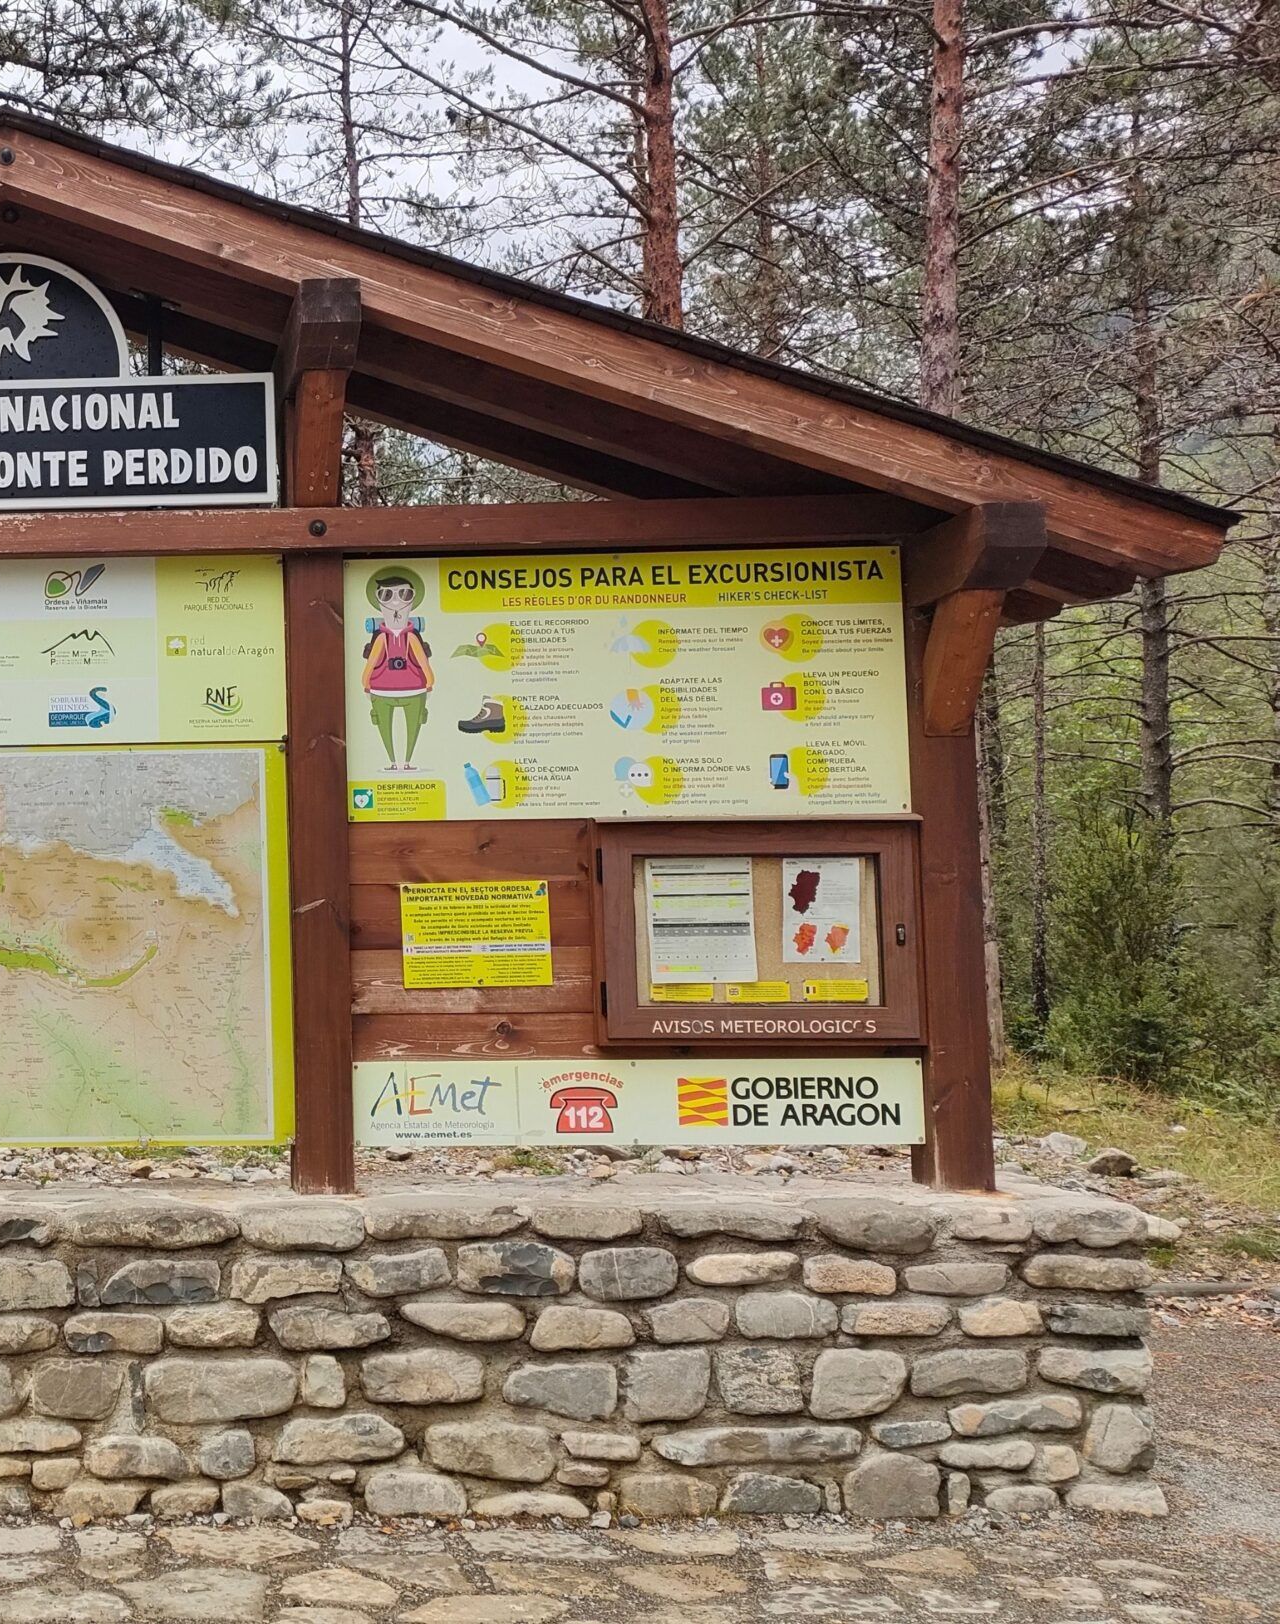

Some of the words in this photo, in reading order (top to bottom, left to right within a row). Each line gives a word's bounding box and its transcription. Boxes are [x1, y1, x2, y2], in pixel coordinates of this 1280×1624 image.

[0, 393, 179, 432] NACIONAL
[104, 446, 258, 486] PERDIDO
[448, 568, 572, 590] CONSEJOS
[581, 567, 643, 587] PARA
[652, 565, 680, 585] EL
[689, 560, 883, 584] EXCURSIONISTA
[503, 598, 521, 606] LES
[525, 594, 564, 606] RÈGLES
[568, 596, 592, 605] D'OR
[596, 596, 609, 604] DU
[613, 594, 686, 604] RANDONNEUR
[719, 592, 760, 601] HIKER'S
[764, 590, 828, 600] CHECK-LIST
[206, 686, 237, 706] RNF
[652, 1020, 714, 1033] AVISOS
[543, 1070, 624, 1089] emergencias
[732, 1076, 878, 1099] GOBIERNO
[565, 1106, 604, 1128] 112
[733, 1104, 768, 1126] DE
[781, 1103, 900, 1126] ARAGON
[371, 1121, 400, 1130] Agencia
[445, 1121, 494, 1130] Meteorología
